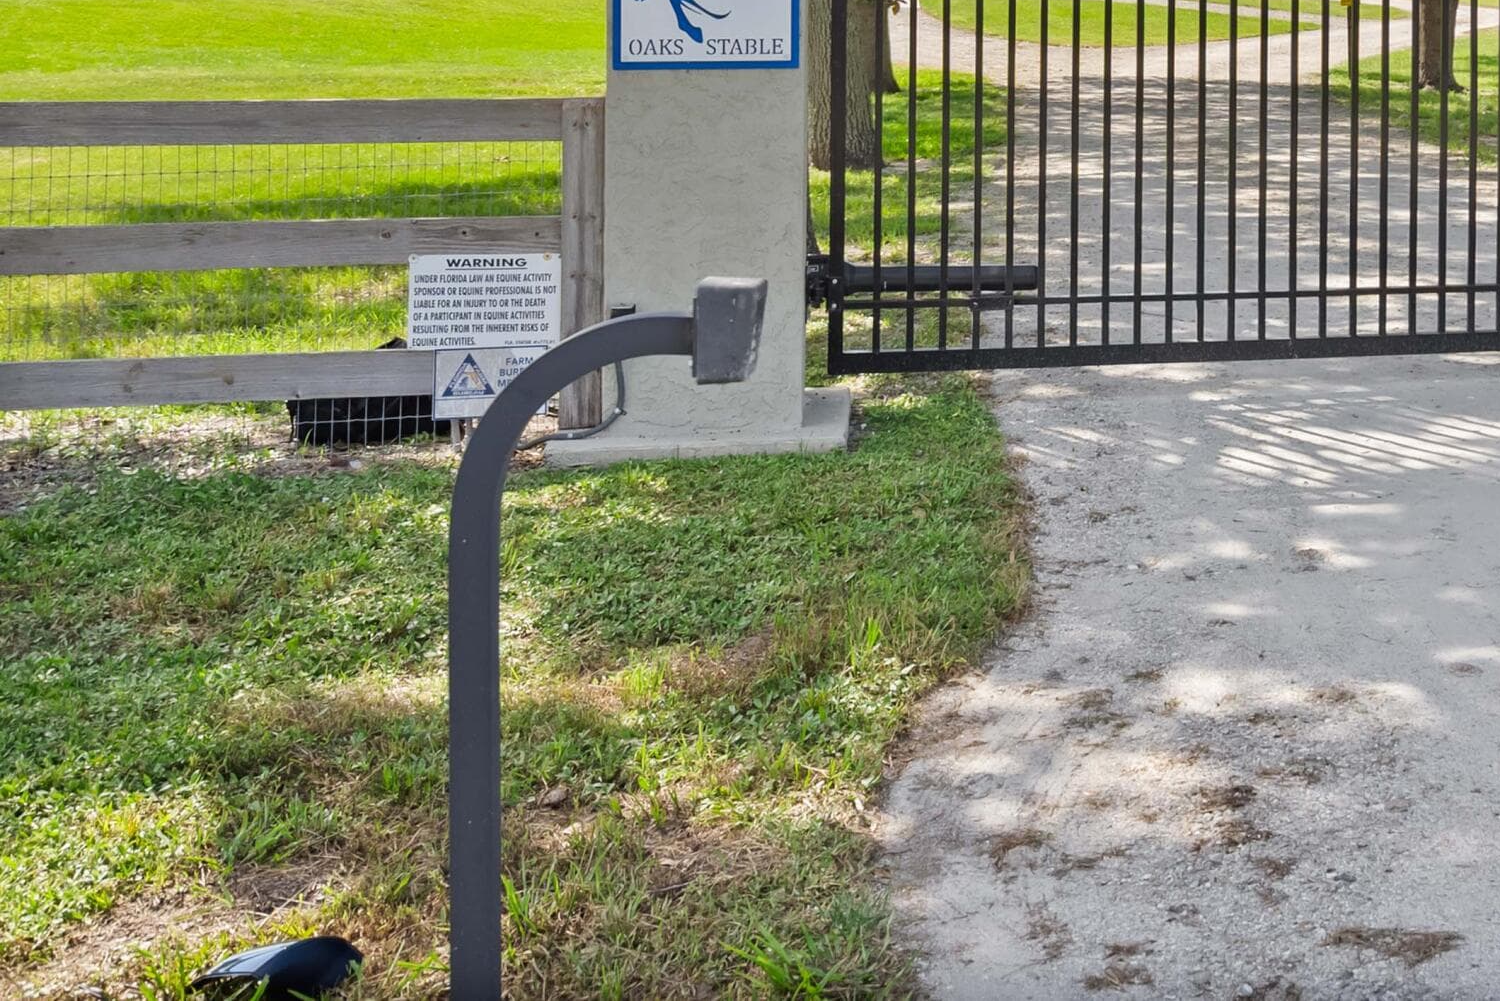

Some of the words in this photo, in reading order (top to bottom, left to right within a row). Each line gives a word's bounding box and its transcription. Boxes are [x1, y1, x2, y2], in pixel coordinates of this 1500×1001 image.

[628, 38, 684, 55] OAKS
[706, 38, 783, 55] STABLE
[446, 258, 528, 267] WARNING
[414, 274, 438, 283] UNDER
[440, 274, 467, 283] FLORIDA
[469, 274, 483, 283] LAW
[485, 274, 494, 282] AN
[496, 273, 521, 282] EQUINE
[523, 273, 552, 282] ACTIVITY
[414, 287, 445, 296] SPONSOR
[447, 287, 457, 296] OR
[459, 287, 483, 295] EQUINE
[485, 286, 533, 295] PROFESSIONAL
[535, 285, 541, 294] IS
[543, 285, 557, 294] NOT
[413, 300, 435, 308] LIABLE
[437, 299, 450, 308] FOR
[452, 299, 461, 308] AN
[463, 299, 487, 308] INJURY
[489, 299, 497, 307] TO
[499, 299, 509, 307] OR
[510, 298, 523, 307] THE
[524, 298, 546, 307] DEATH
[413, 312, 422, 321] OF
[424, 312, 429, 321] A
[430, 312, 472, 320] PARTICIPANT
[473, 311, 481, 320] IN
[483, 311, 509, 320] EQUINE
[510, 310, 545, 319] ACTIVITIES
[412, 325, 449, 334] RESULTING
[450, 324, 470, 333] FROM
[472, 324, 484, 333] THE
[486, 323, 519, 332] INHERENT
[520, 323, 539, 332] RISKS
[540, 322, 549, 331] OF
[412, 337, 438, 347] EQUINE
[439, 337, 476, 346] ACTIVITIES.
[505, 357, 533, 365] FARM
